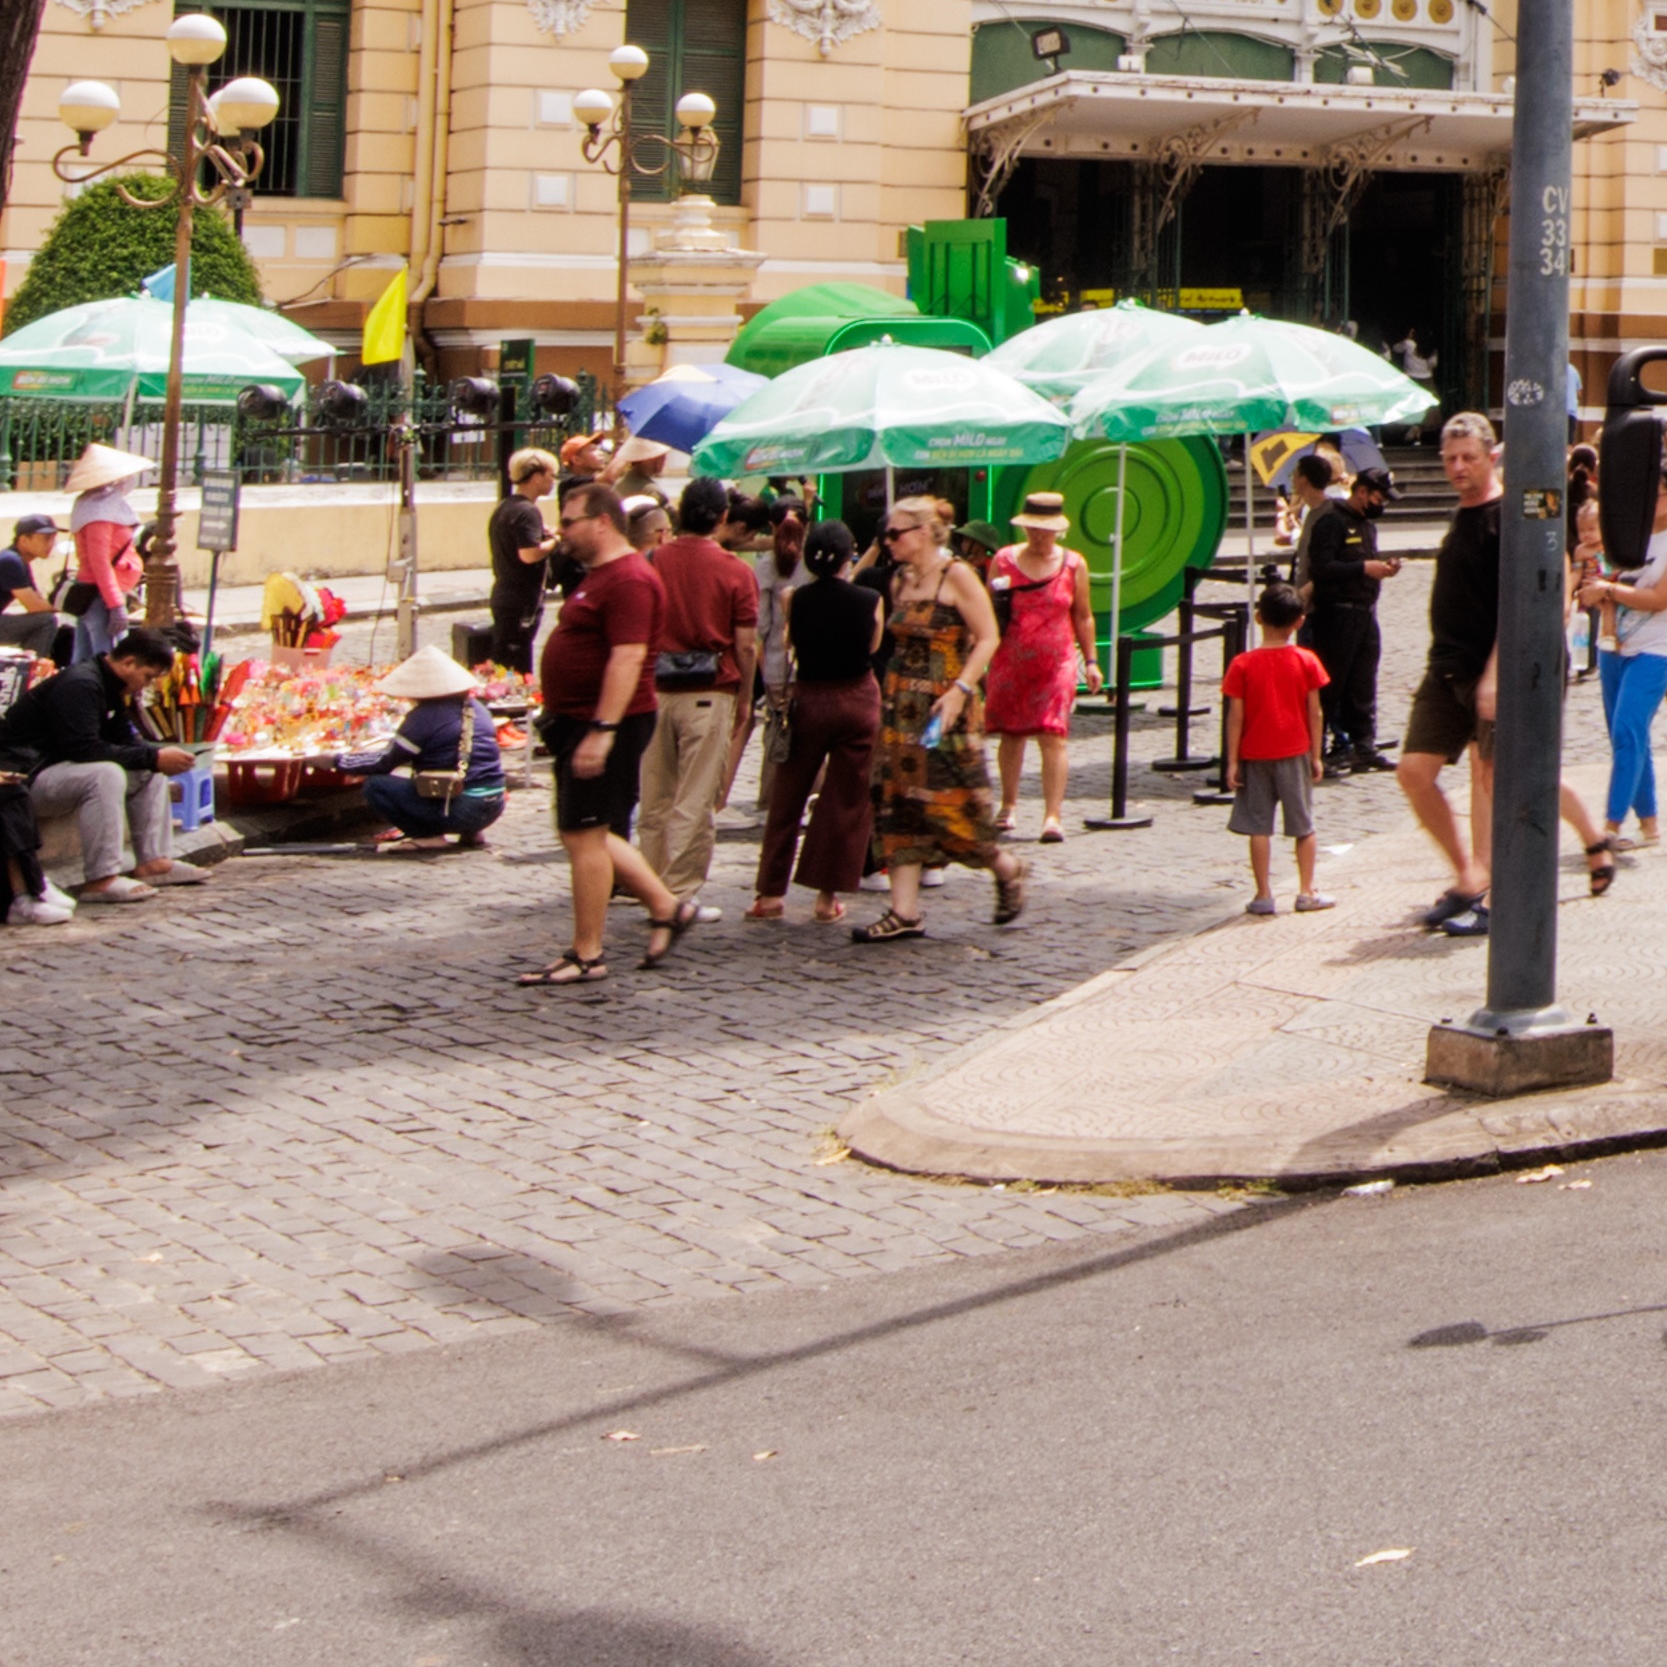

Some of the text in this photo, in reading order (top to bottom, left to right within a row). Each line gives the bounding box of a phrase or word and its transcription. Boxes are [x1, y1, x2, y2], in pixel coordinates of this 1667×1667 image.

[1542, 185, 1568, 214] CV
[1541, 219, 1567, 247] 33
[1540, 247, 1566, 277] 34
[1183, 346, 1243, 364] MILO
[952, 433, 985, 448] MILO
